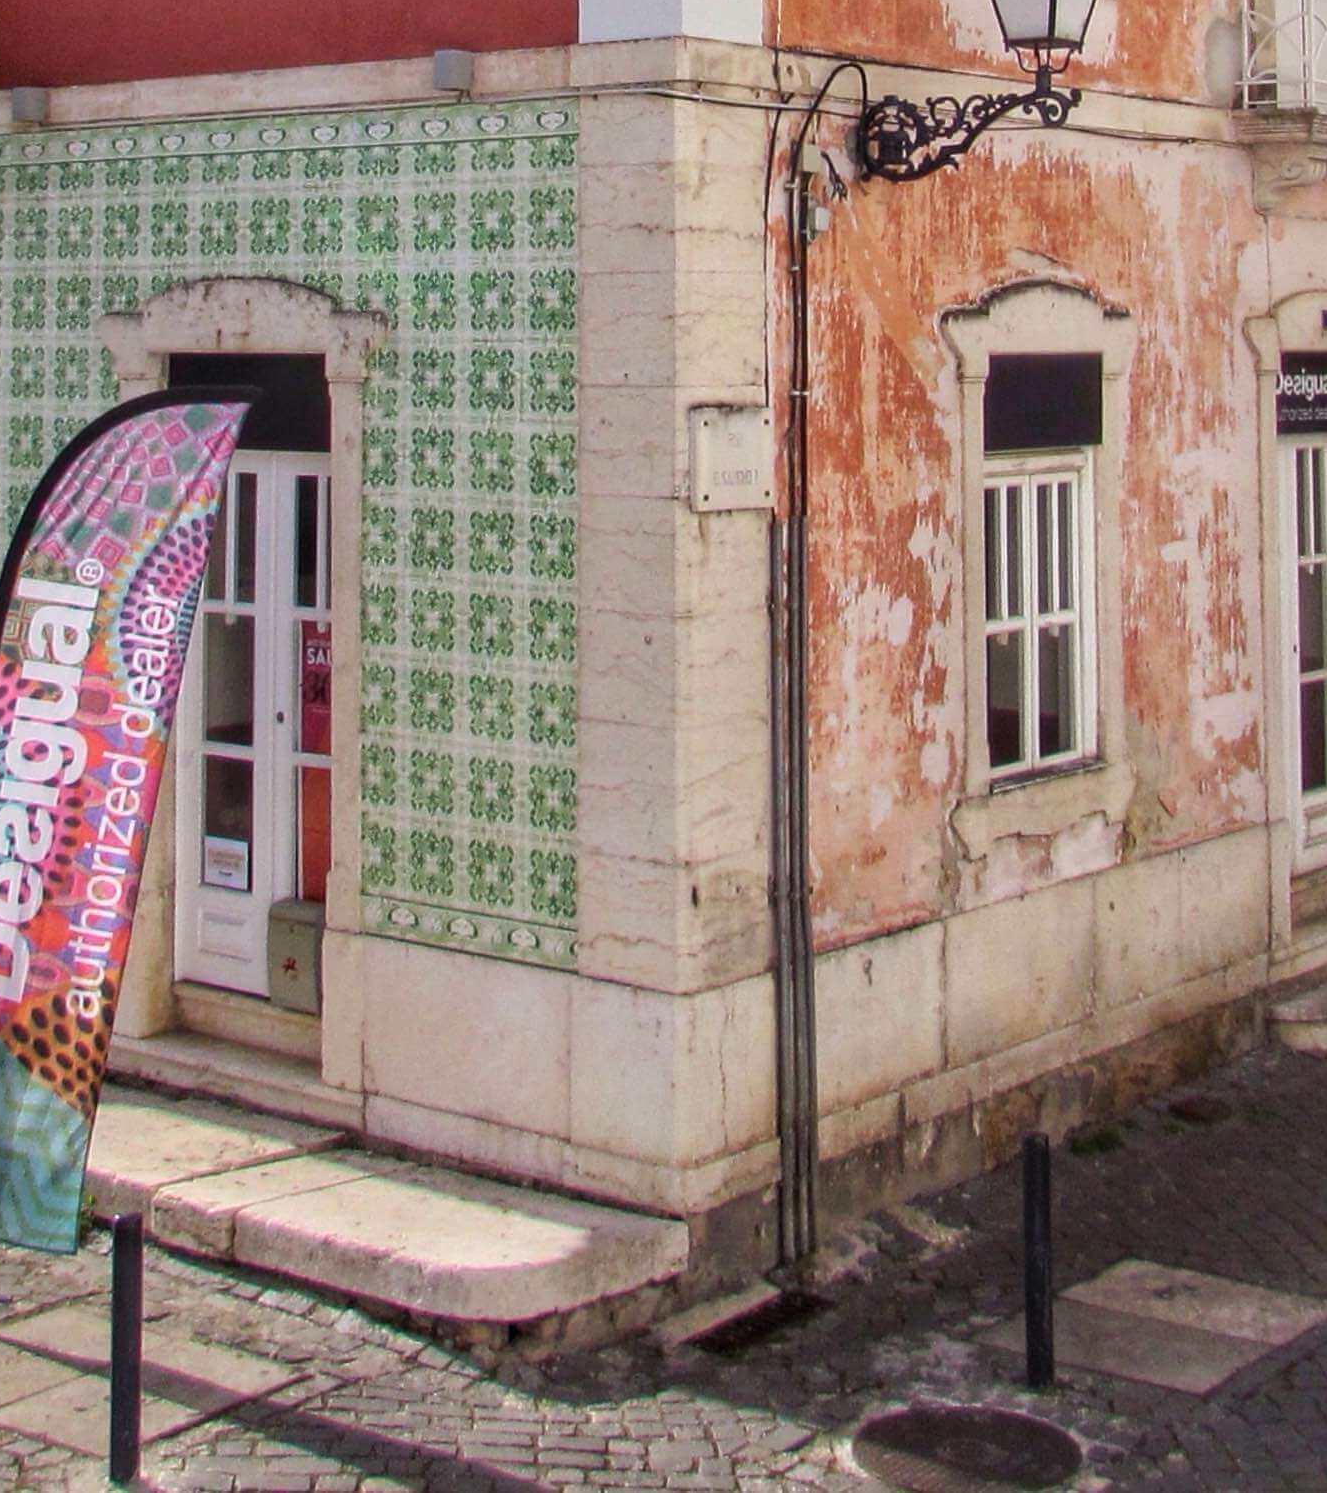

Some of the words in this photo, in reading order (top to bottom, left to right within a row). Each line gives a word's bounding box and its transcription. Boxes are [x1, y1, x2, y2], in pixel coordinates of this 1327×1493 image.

[307, 648, 333, 665] SAL
[66, 750, 148, 1019] authorized
[113, 584, 180, 739] dealer
